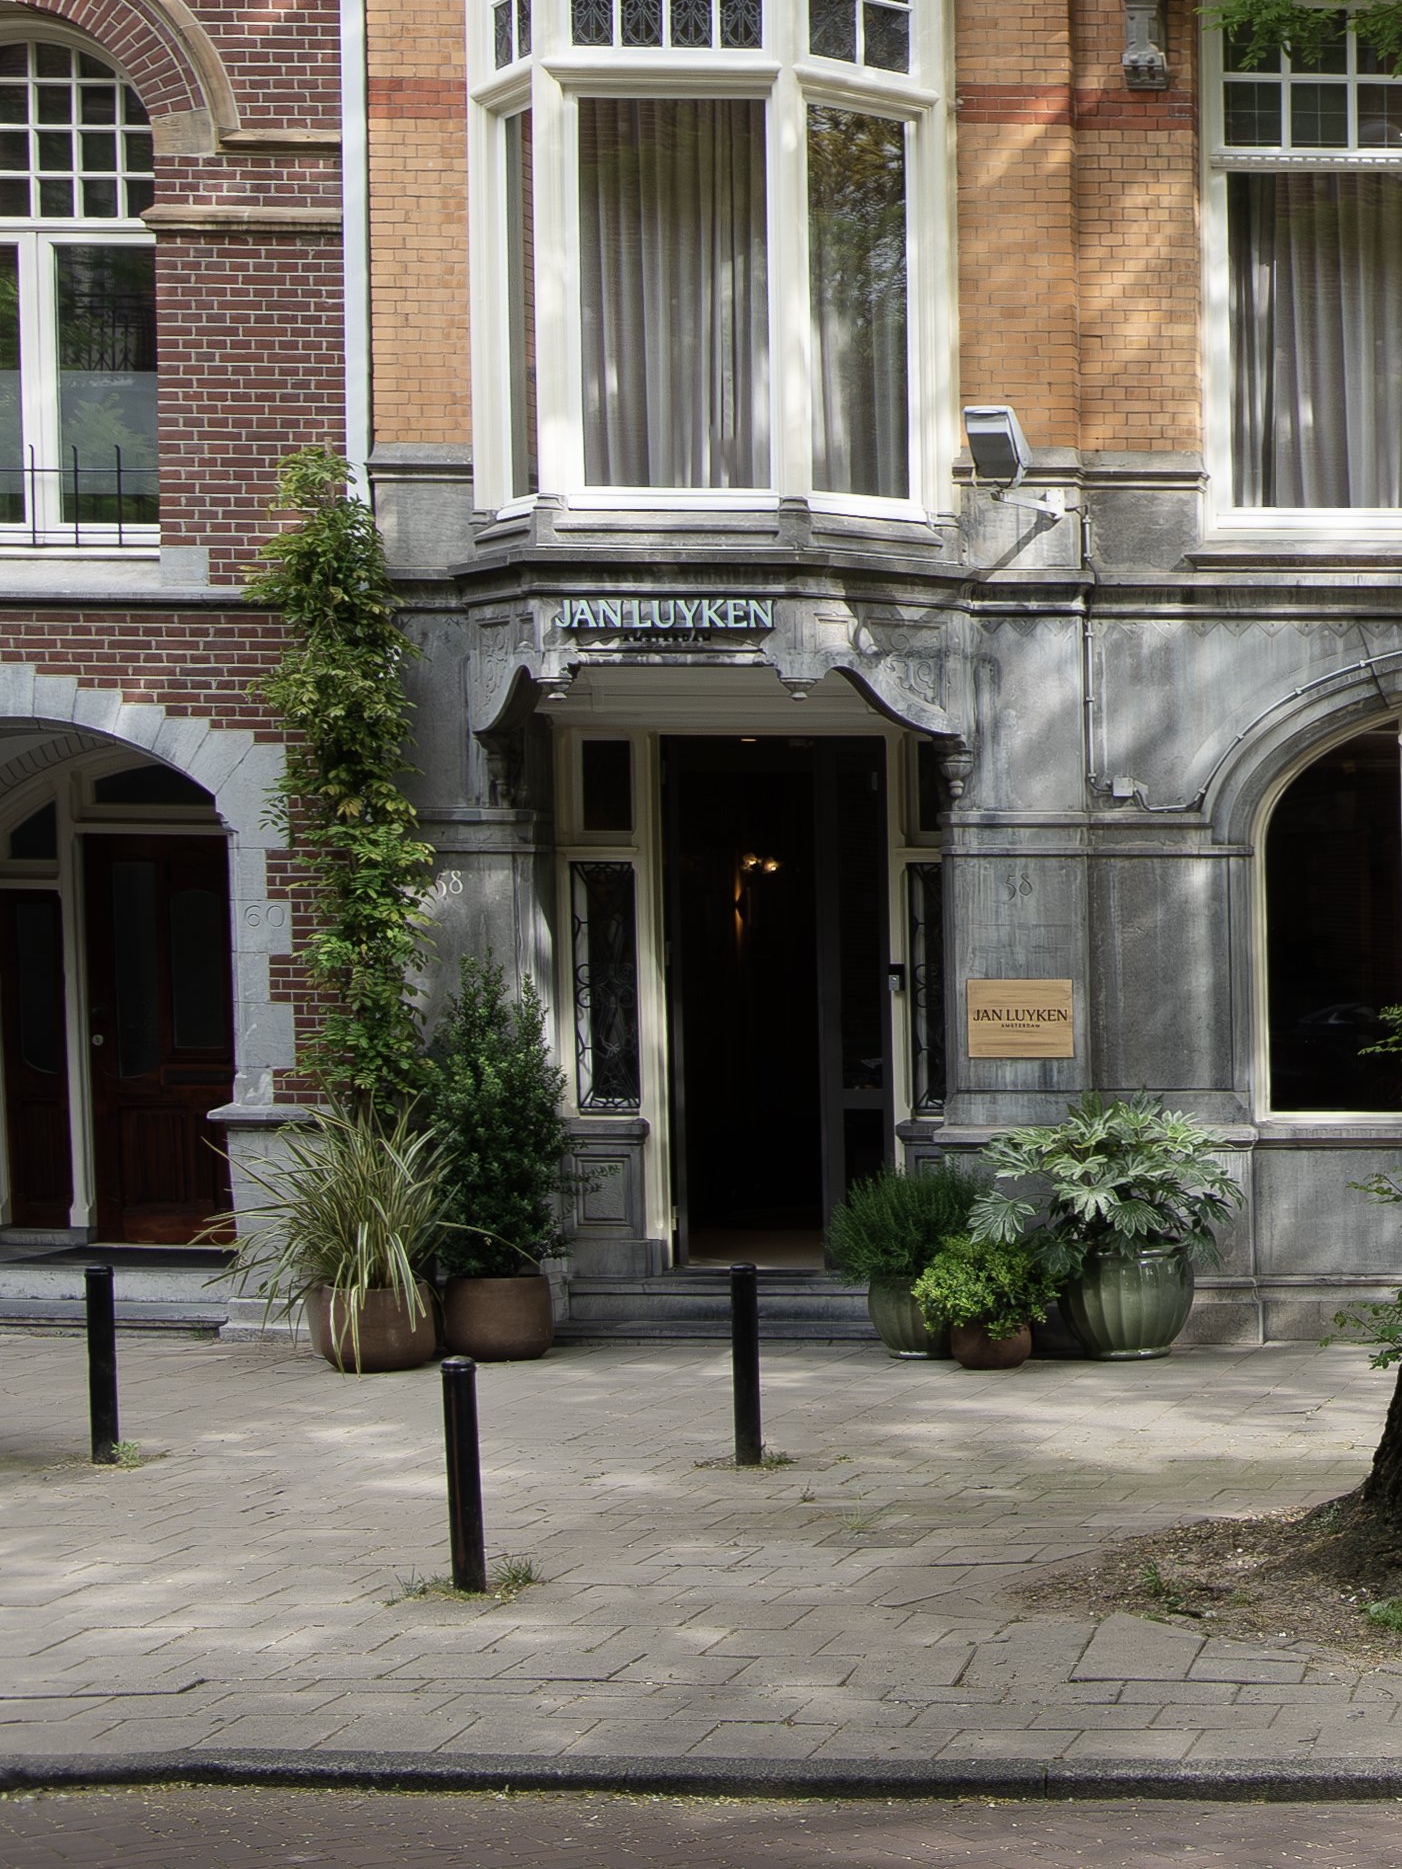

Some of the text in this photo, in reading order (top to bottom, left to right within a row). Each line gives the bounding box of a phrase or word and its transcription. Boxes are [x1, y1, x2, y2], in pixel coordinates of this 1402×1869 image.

[556, 598, 775, 629] JAN LUYKEN
[622, 632, 712, 642] AMSTERDAM
[435, 869, 463, 898] 58
[1004, 872, 1033, 901] 58
[243, 905, 285, 928] 60
[973, 1009, 1068, 1022] JAN LUYKEN
